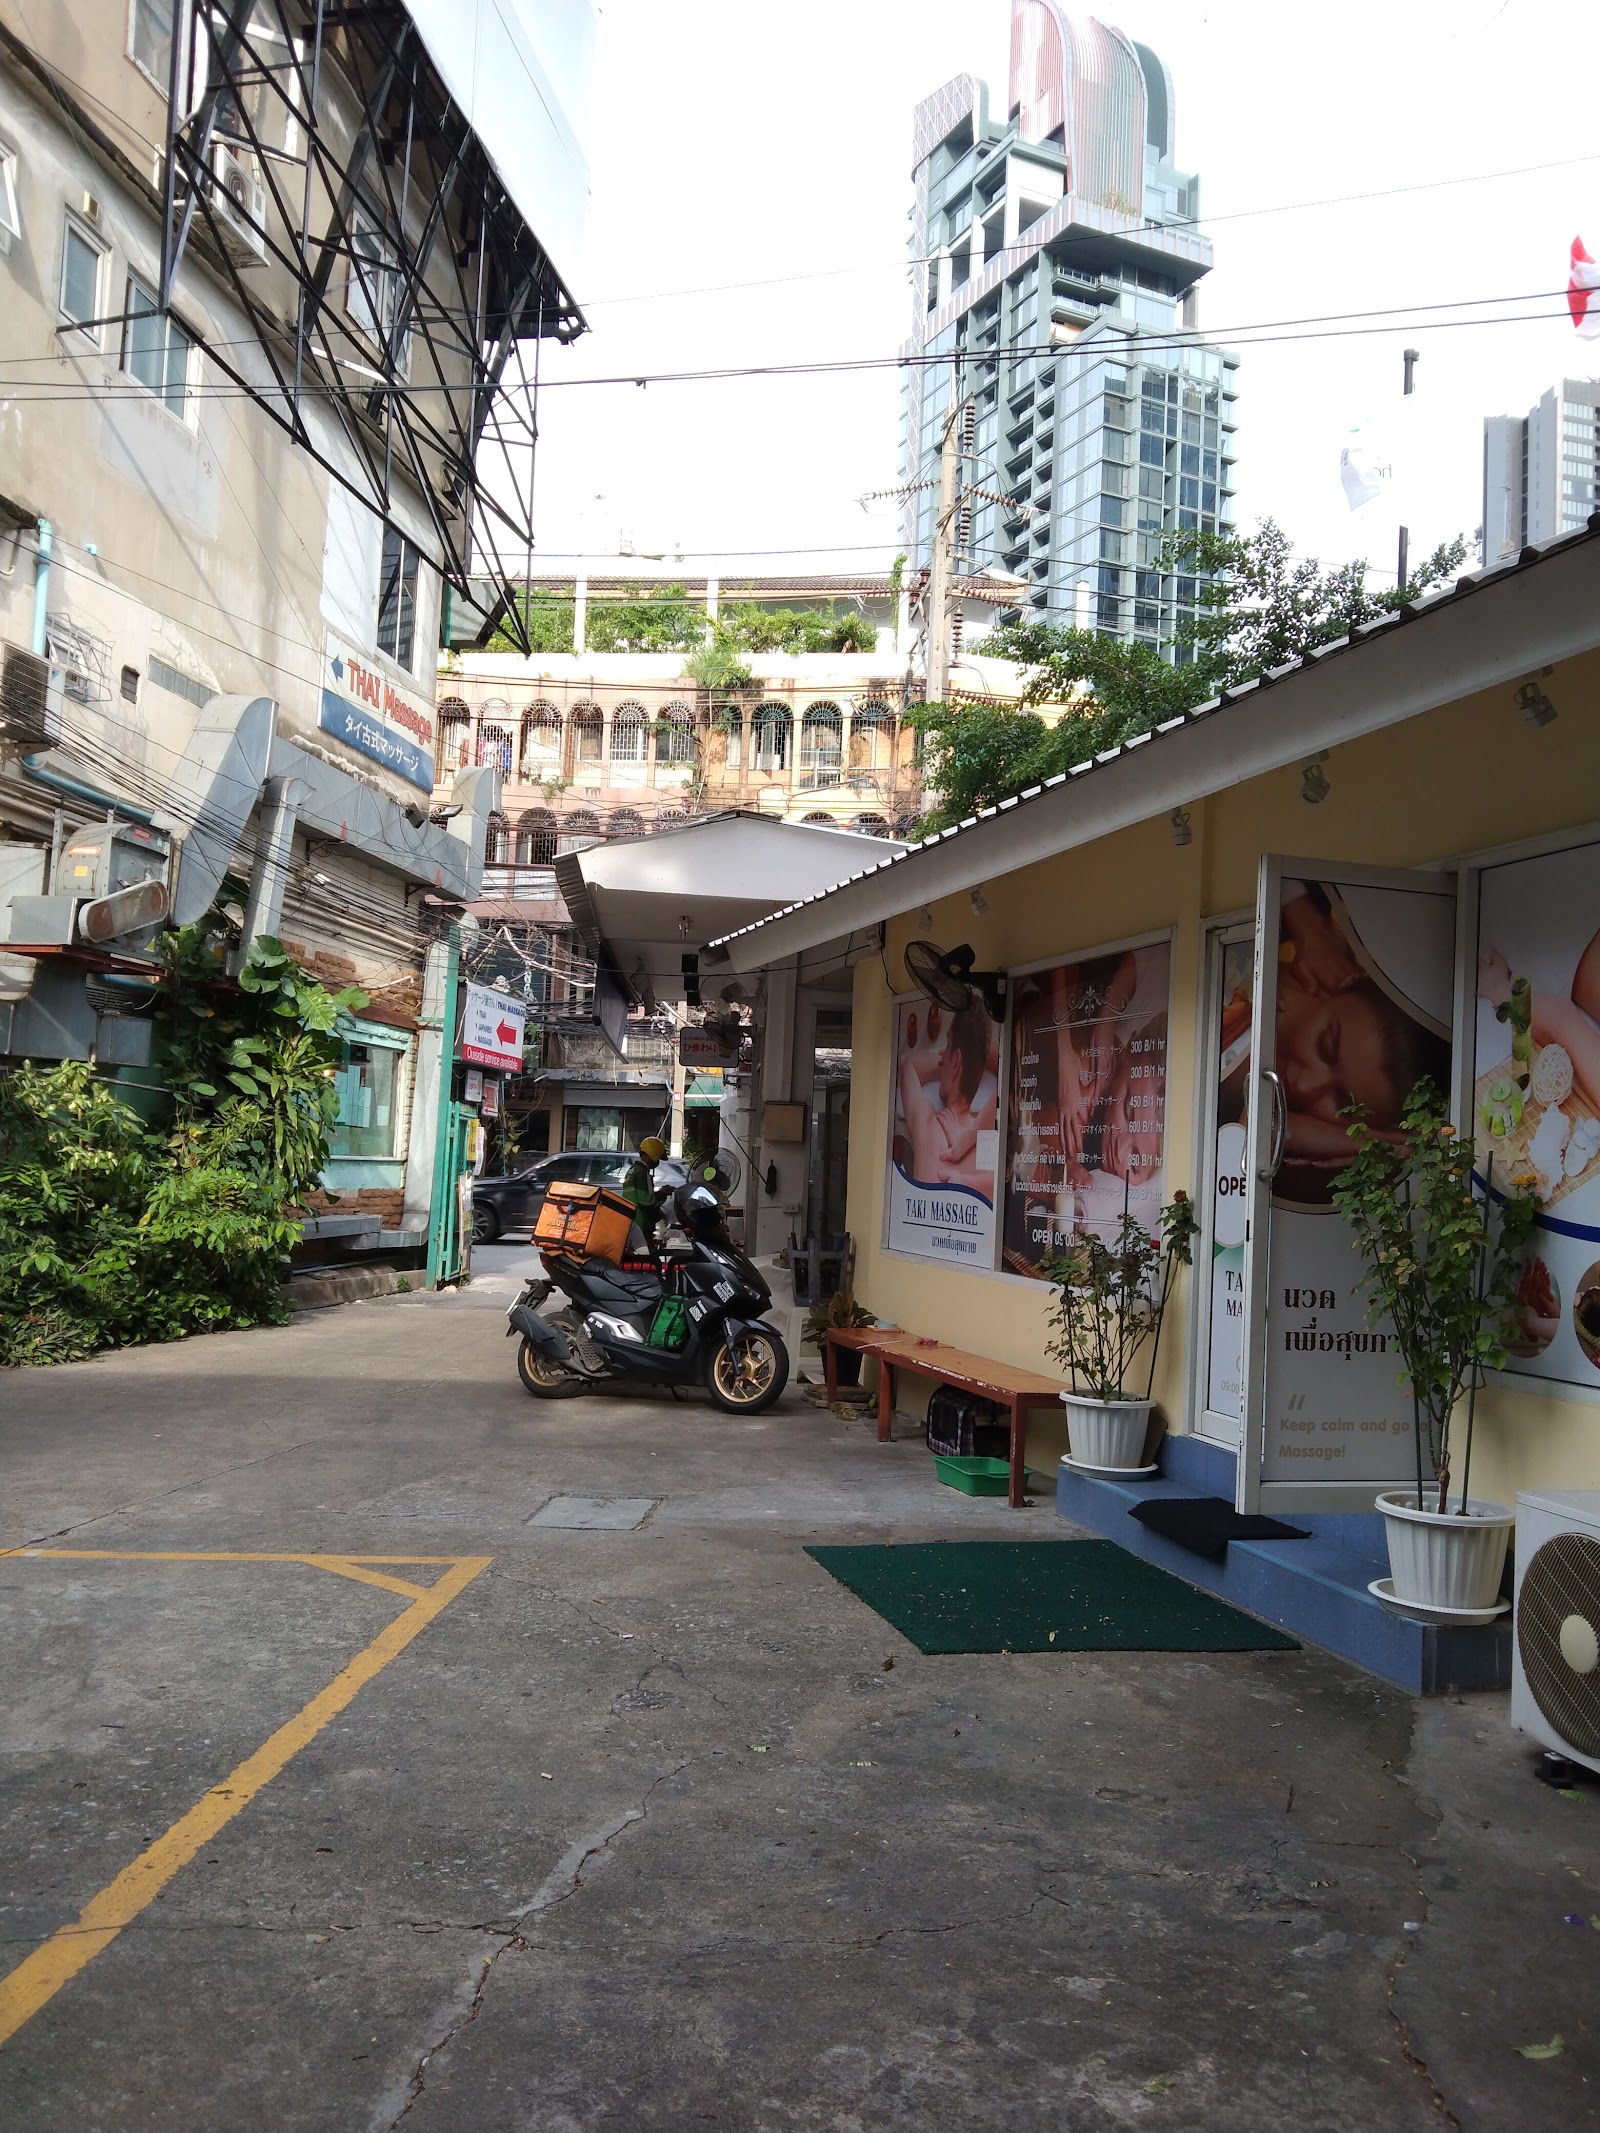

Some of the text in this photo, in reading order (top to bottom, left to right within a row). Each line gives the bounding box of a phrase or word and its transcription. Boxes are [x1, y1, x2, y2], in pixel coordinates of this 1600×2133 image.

[348, 657, 433, 745] THAI Massage
[345, 713, 419, 771] タイ古式マッサージ
[683, 1043, 717, 1053] ひまわり
[1130, 1038, 1166, 1054] 300 B/1 hr
[484, 1053, 500, 1067] service
[500, 1057, 518, 1070] available
[1130, 1064, 1166, 1079] 300 B/1 hr
[1129, 1094, 1165, 1108] 450 B/1 hr
[1128, 1120, 1164, 1133] 600 B/1 hr
[1128, 1154, 1163, 1167] 350 B/1 hr
[1218, 1175, 1246, 1197] OPE
[906, 1198, 979, 1226] TAKI MASSAGE
[1032, 1229, 1053, 1245] OPEN
[1225, 1270, 1243, 1293] TA
[1283, 1288, 1336, 1309] นวด
[1226, 1298, 1243, 1318] MA
[1285, 1317, 1422, 1361] เพื่อสุขภา
[1280, 1417, 1316, 1434] Keep
[1321, 1417, 1355, 1432] calm
[1360, 1418, 1387, 1432] and
[1392, 1421, 1410, 1435] go
[1279, 1444, 1346, 1461] Massage!
